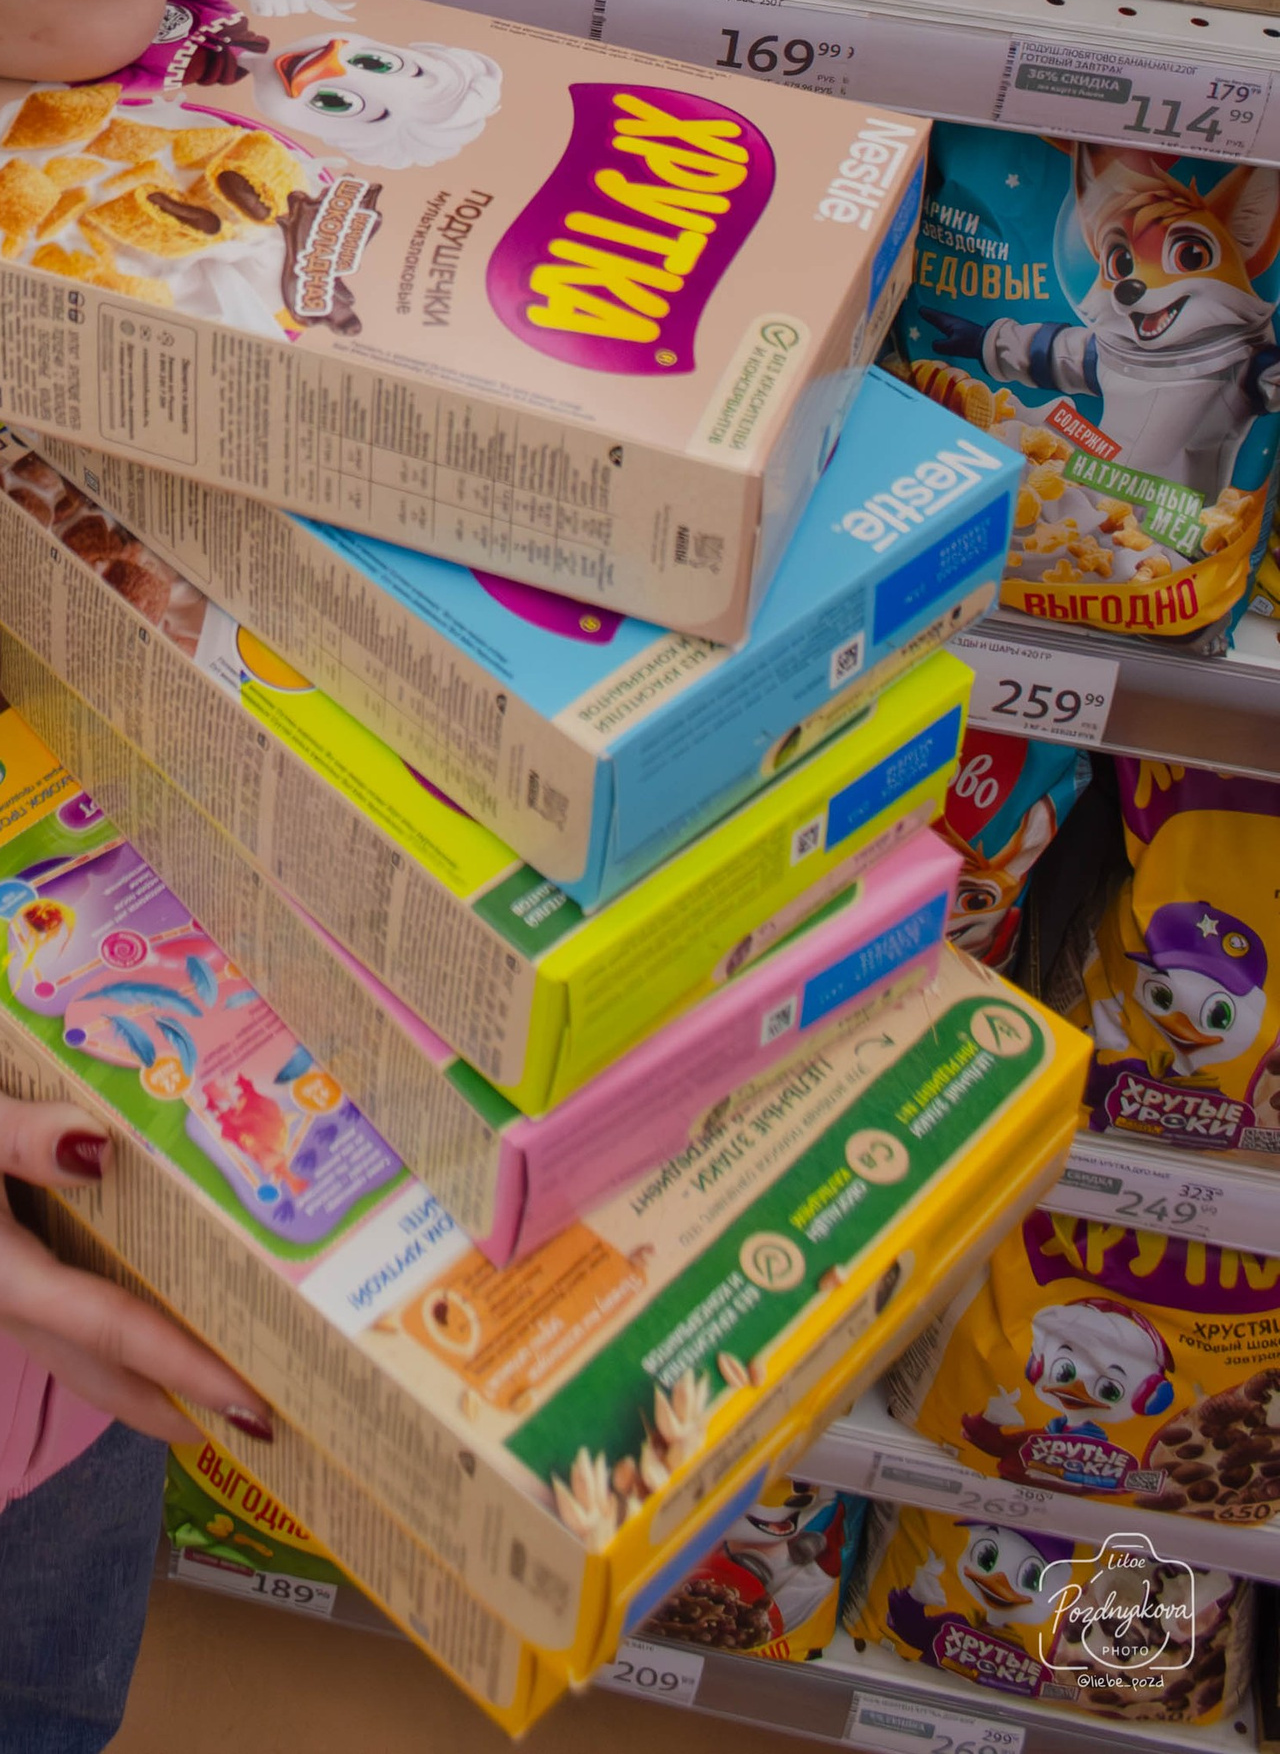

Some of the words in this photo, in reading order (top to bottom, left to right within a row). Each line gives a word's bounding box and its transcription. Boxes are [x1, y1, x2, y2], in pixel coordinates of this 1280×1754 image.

[716, 28, 814, 76] 169
[818, 42, 841, 57] 99
[1020, 52, 1072, 67] ГОТОВЫЙ
[1074, 62, 1123, 74] ЗАВТРАК
[1027, 69, 1058, 82] 36%
[1061, 73, 1120, 91] СКИДКА
[1206, 82, 1249, 102] 179
[1123, 95, 1222, 143] 114
[1230, 109, 1254, 124] 99
[525, 92, 750, 344] ХРУТКА
[297, 180, 364, 312] ШОКОЛАДНАЯ
[396, 190, 451, 315] мультизлаковые
[421, 189, 494, 328] ПОДУШЕЧКИ
[916, 250, 1050, 300] ЕДОВЫЕ
[1052, 405, 1116, 459] СОДЕРЖИТ
[1073, 454, 1202, 518] НАТУРАЛЬНЫЙ
[1024, 577, 1198, 628] ВЫГОДНО
[992, 679, 1082, 723] 259
[1085, 693, 1105, 707] 99
[1121, 1077, 1245, 1122] ХРУТЫЕ
[1115, 1190, 1197, 1225] 249
[1178, 1185, 1213, 1202] 323
[1033, 1436, 1131, 1472] ХРУТЫЕ
[958, 1493, 1031, 1518] 269
[1218, 1503, 1271, 1521] 650
[250, 1571, 315, 1606] 189
[947, 1630, 1041, 1680] ХРУТЫЕ
[613, 1662, 679, 1693] 209
[983, 1730, 1012, 1744] 299
